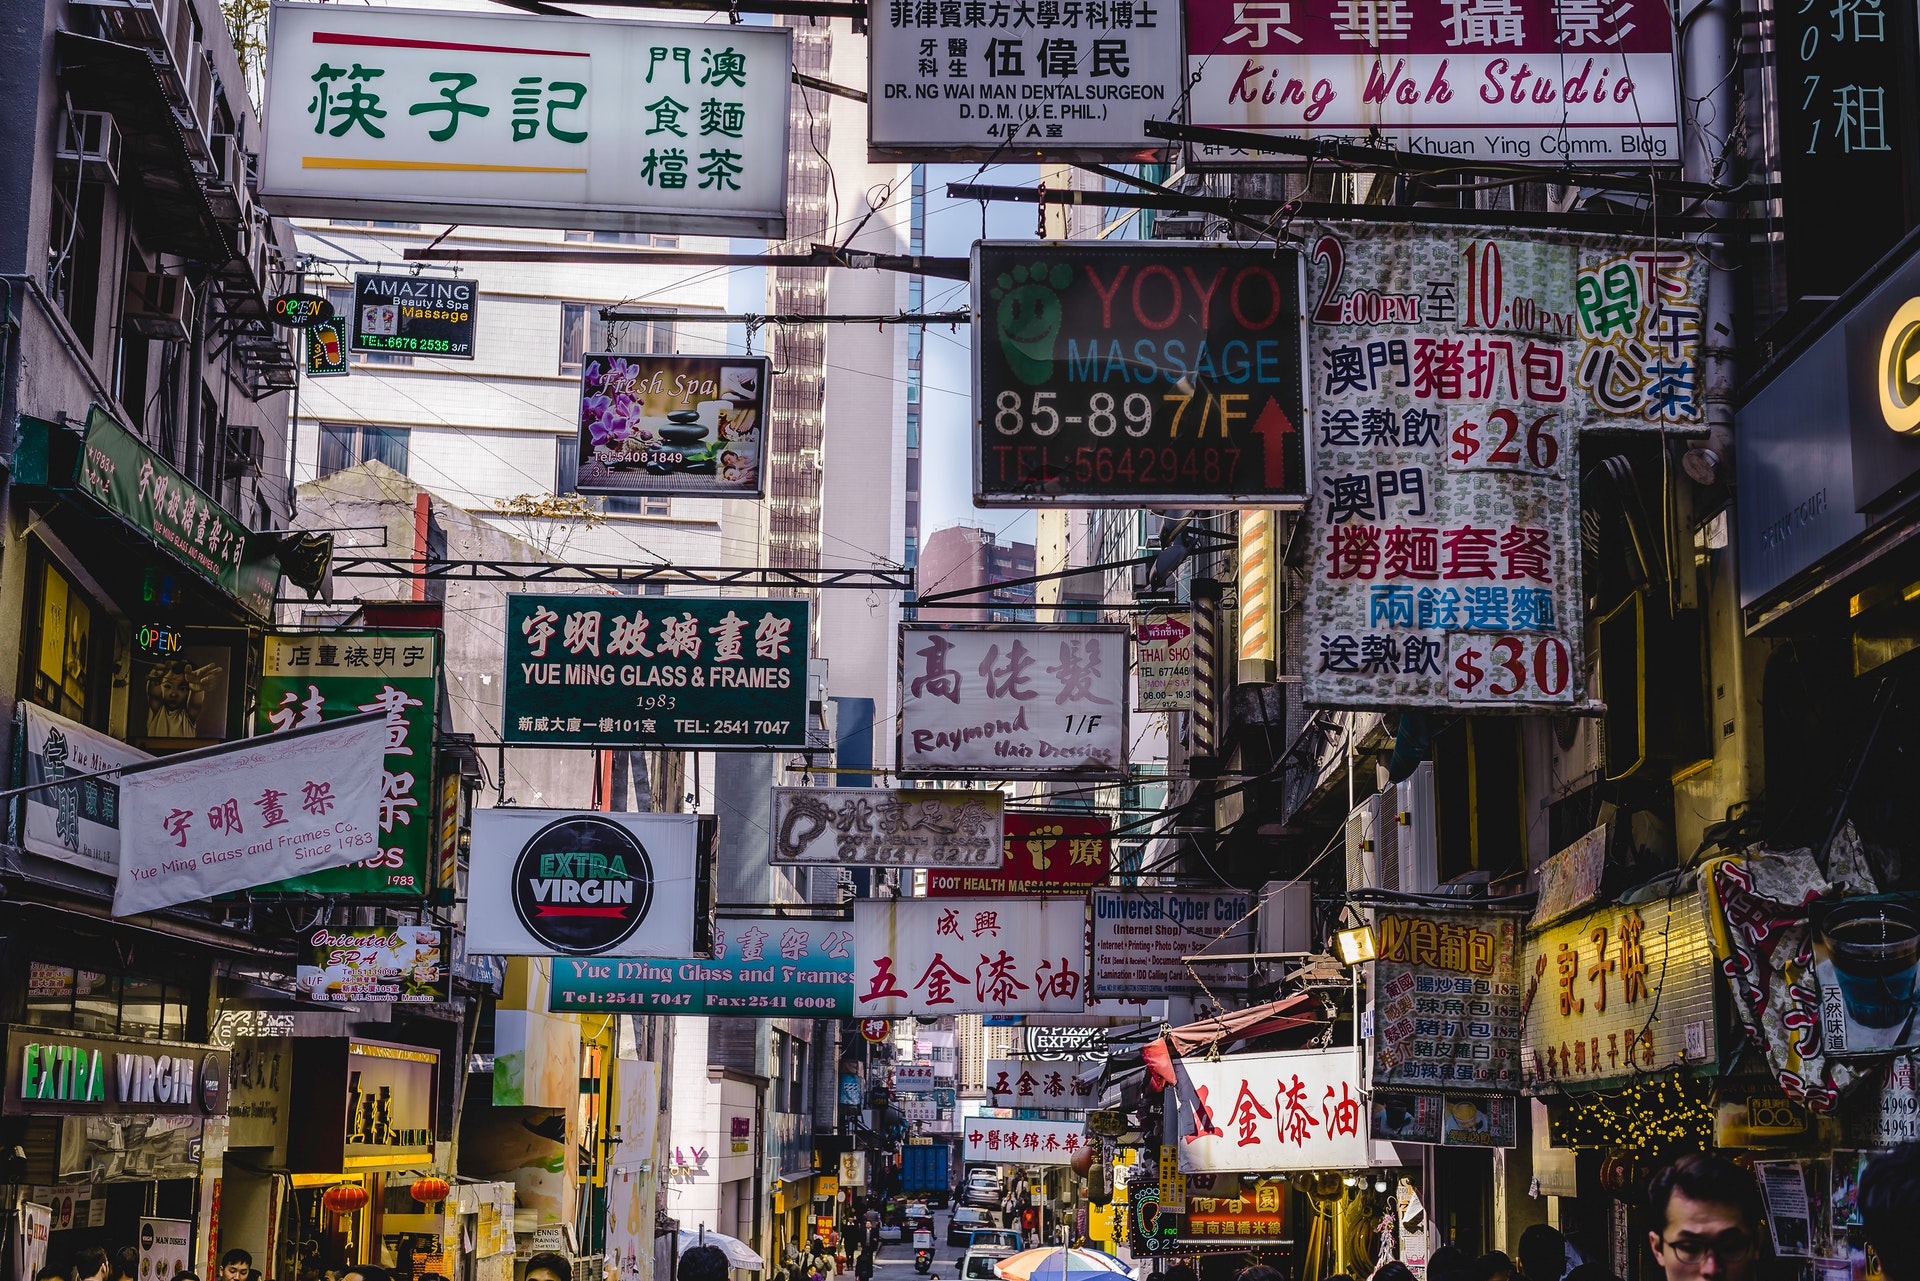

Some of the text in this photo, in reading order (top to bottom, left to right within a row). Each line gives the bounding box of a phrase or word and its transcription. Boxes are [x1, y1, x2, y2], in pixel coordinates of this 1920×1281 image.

[984, 38, 1130, 78] 伍偉民
[1228, 57, 1636, 121] King Wah Studio
[1830, 0, 1892, 153] 招租
[307, 62, 588, 143] 筷子記
[884, 84, 1164, 100] DR. NG WAI MAN DENTAL SURGEON
[1045, 124, 1063, 138] 室
[1409, 136, 1474, 156] Khuan
[1485, 137, 1530, 158] Ying
[1540, 137, 1611, 156] Comm.
[1621, 136, 1667, 158] Bldg
[364, 279, 470, 300] AMAZING
[1084, 264, 1281, 330] YOYO
[1426, 281, 1456, 322] 至
[276, 300, 322, 316] OPEN
[393, 297, 469, 311] Beauty Spa
[401, 306, 469, 323] Massage
[451, 343, 468, 352] 3/F
[1067, 339, 1281, 383] MASSAGE
[1323, 338, 1566, 402] 澳門豬扒包
[596, 370, 716, 404] Fresh Spa
[994, 390, 1249, 439] 85-89 7/F
[1320, 407, 1560, 468] 送熱飲 $26
[653, 452, 683, 463] 1849
[1322, 468, 1426, 524] 澳門
[1326, 524, 1553, 584] 撈麵套餐
[140, 627, 178, 652] OPEN
[1140, 648, 1191, 662] THAI SHO
[1320, 634, 1569, 695] 送熱飲 $30
[521, 663, 792, 689] YUE MING GLASS & FRAMES
[911, 634, 1113, 705] 高佬髮
[1140, 668, 1154, 677] TEL
[637, 694, 675, 711] 1983
[674, 720, 710, 734] TEL:
[714, 721, 748, 735] 2541
[754, 721, 790, 735] 7047
[912, 705, 1102, 753] Raymond 1/F
[73, 745, 88, 766] Yue
[994, 739, 1112, 761] Hair Dressing
[163, 780, 336, 848] 宇明畫架
[130, 822, 357, 881] Yue Ming Glass and Frames Co.
[294, 843, 331, 860] Since
[338, 831, 373, 848] 1983
[540, 852, 628, 879] EXTRA
[387, 875, 414, 886] 1983
[529, 879, 632, 904] VIRGIN
[932, 876, 960, 889] FOOT
[964, 878, 1005, 892] HEALTH
[1097, 896, 1246, 924] Universal Cyber Café
[937, 907, 1002, 940] 成興
[1113, 924, 1181, 937] (Internet Shop)
[310, 928, 397, 947] Oriental
[1100, 941, 1187, 953] Internet Printing Photo Copy
[1380, 914, 1495, 975] 必食葡包
[327, 950, 378, 966] SPA
[1100, 955, 1111, 965] Fax
[572, 960, 855, 984] Yue Ming Glass and Frames
[859, 950, 1079, 1006] 五金漆油
[1100, 970, 1167, 982] Lamination Calling
[651, 993, 693, 1005] 7047
[794, 995, 836, 1008] 6008
[866, 1019, 885, 1037] 押
[1825, 987, 1844, 1051] 天然味道
[21, 1042, 105, 1101] EXTRA
[117, 1052, 194, 1104] VIRGIN
[1191, 1220, 1282, 1236] 雲南過橋米線
[155, 1237, 187, 1246] MAIN DISHES
